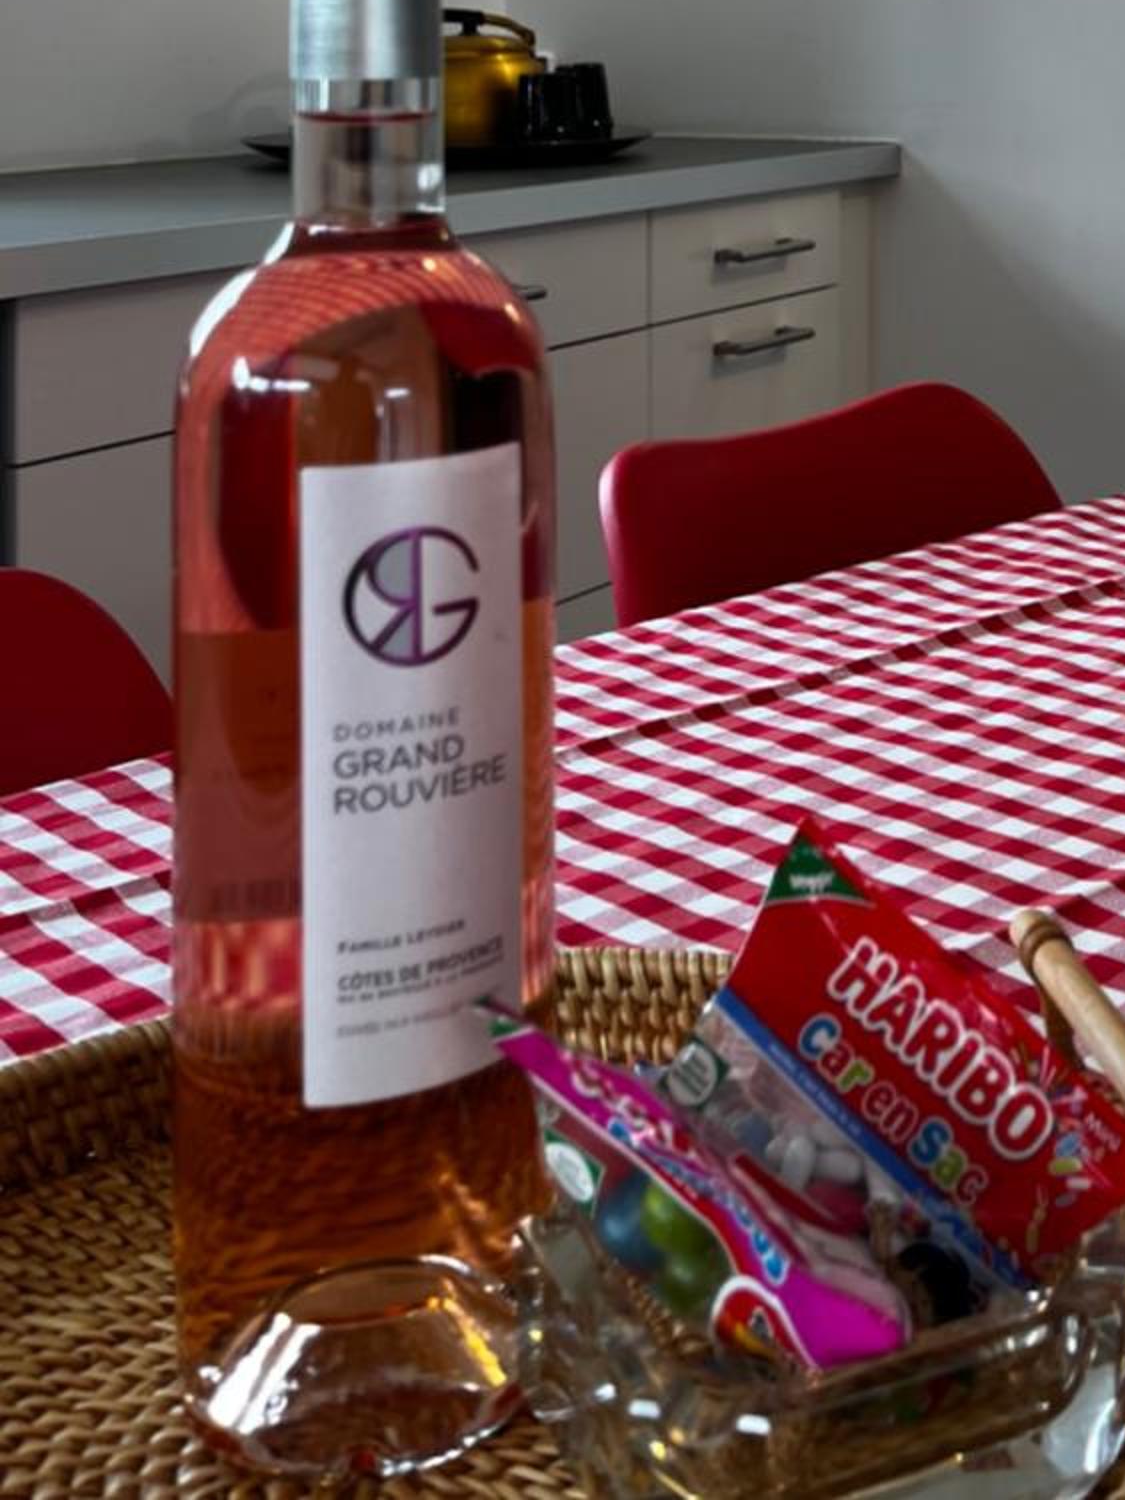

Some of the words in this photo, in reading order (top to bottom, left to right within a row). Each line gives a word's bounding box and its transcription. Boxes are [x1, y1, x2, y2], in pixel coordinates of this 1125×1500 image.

[333, 706, 460, 742] DOMAINE
[333, 734, 465, 779] GRAND
[398, 963, 421, 983] DE
[827, 937, 1053, 1160] HARIBO
[798, 1014, 874, 1093] Car
[861, 1081, 919, 1145] en
[908, 1117, 989, 1206] Sac
